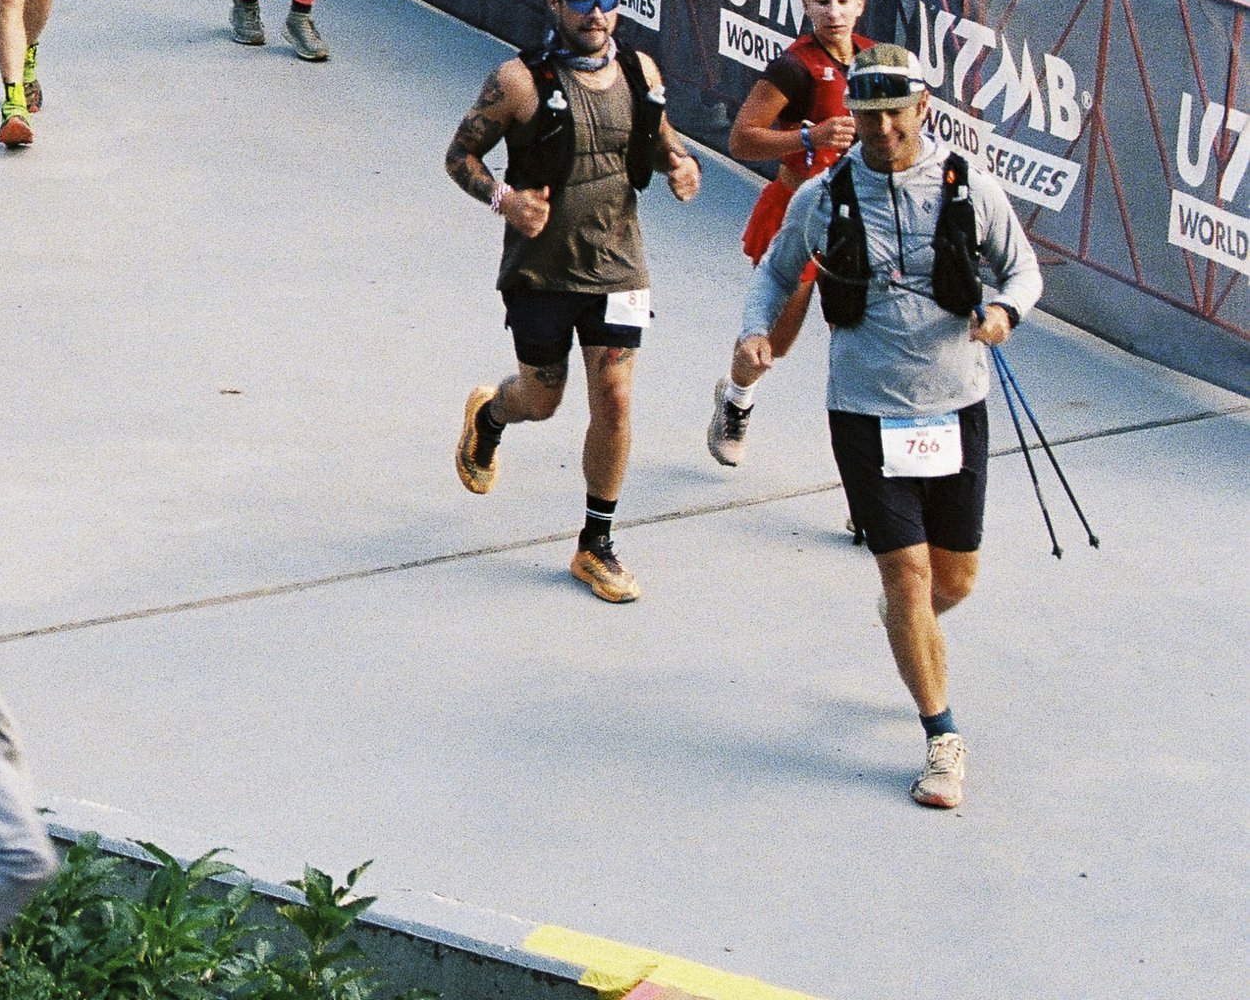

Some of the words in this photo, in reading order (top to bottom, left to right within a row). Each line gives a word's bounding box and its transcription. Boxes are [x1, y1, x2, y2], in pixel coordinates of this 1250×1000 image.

[985, 144, 1069, 198] SERIES
[1178, 203, 1250, 261] WORLD
[905, 438, 941, 455] 766
